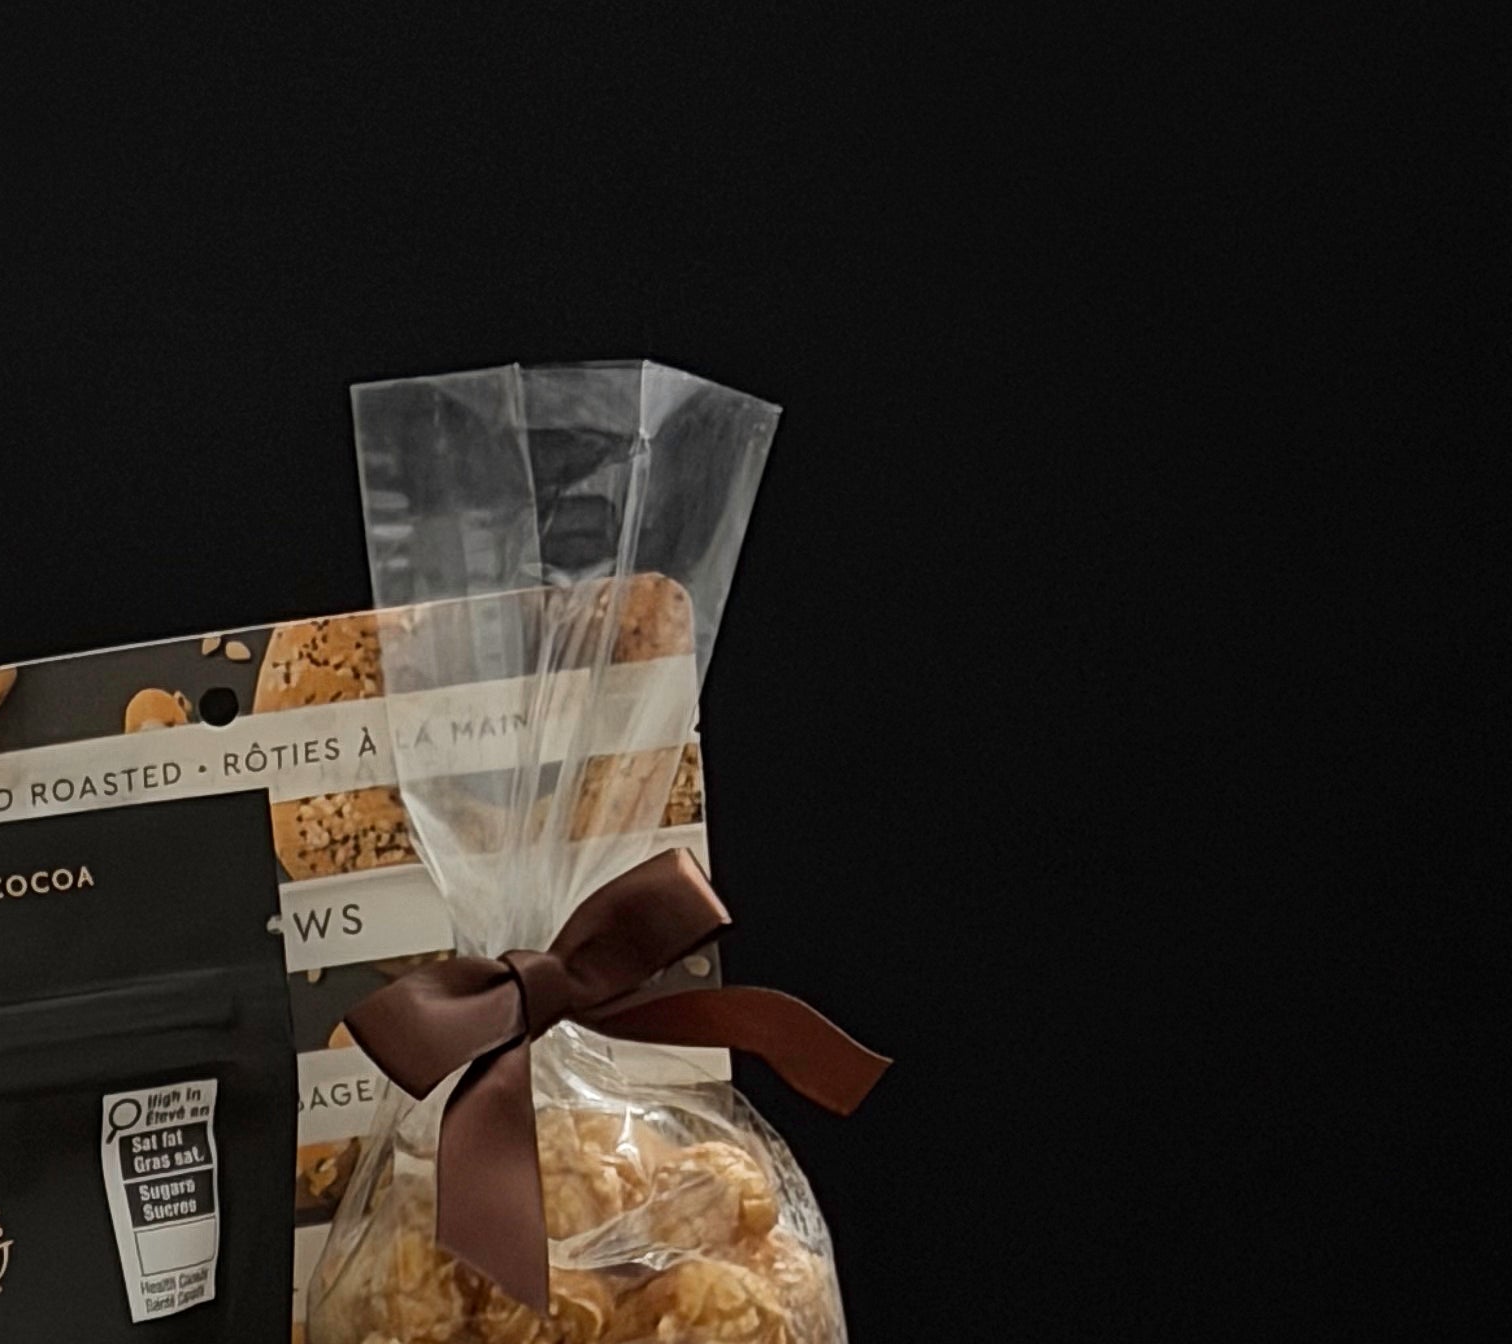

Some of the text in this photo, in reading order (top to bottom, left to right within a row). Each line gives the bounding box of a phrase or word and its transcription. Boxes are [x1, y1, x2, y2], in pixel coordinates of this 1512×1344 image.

[31, 762, 181, 807] ROASTED
[223, 737, 340, 776] RÔTIES
[358, 726, 377, 758] À
[131, 1128, 183, 1153] Sat fat
[133, 1154, 171, 1174] Gras
[139, 1179, 196, 1201] Sugars
[142, 1199, 197, 1221] Sucres
